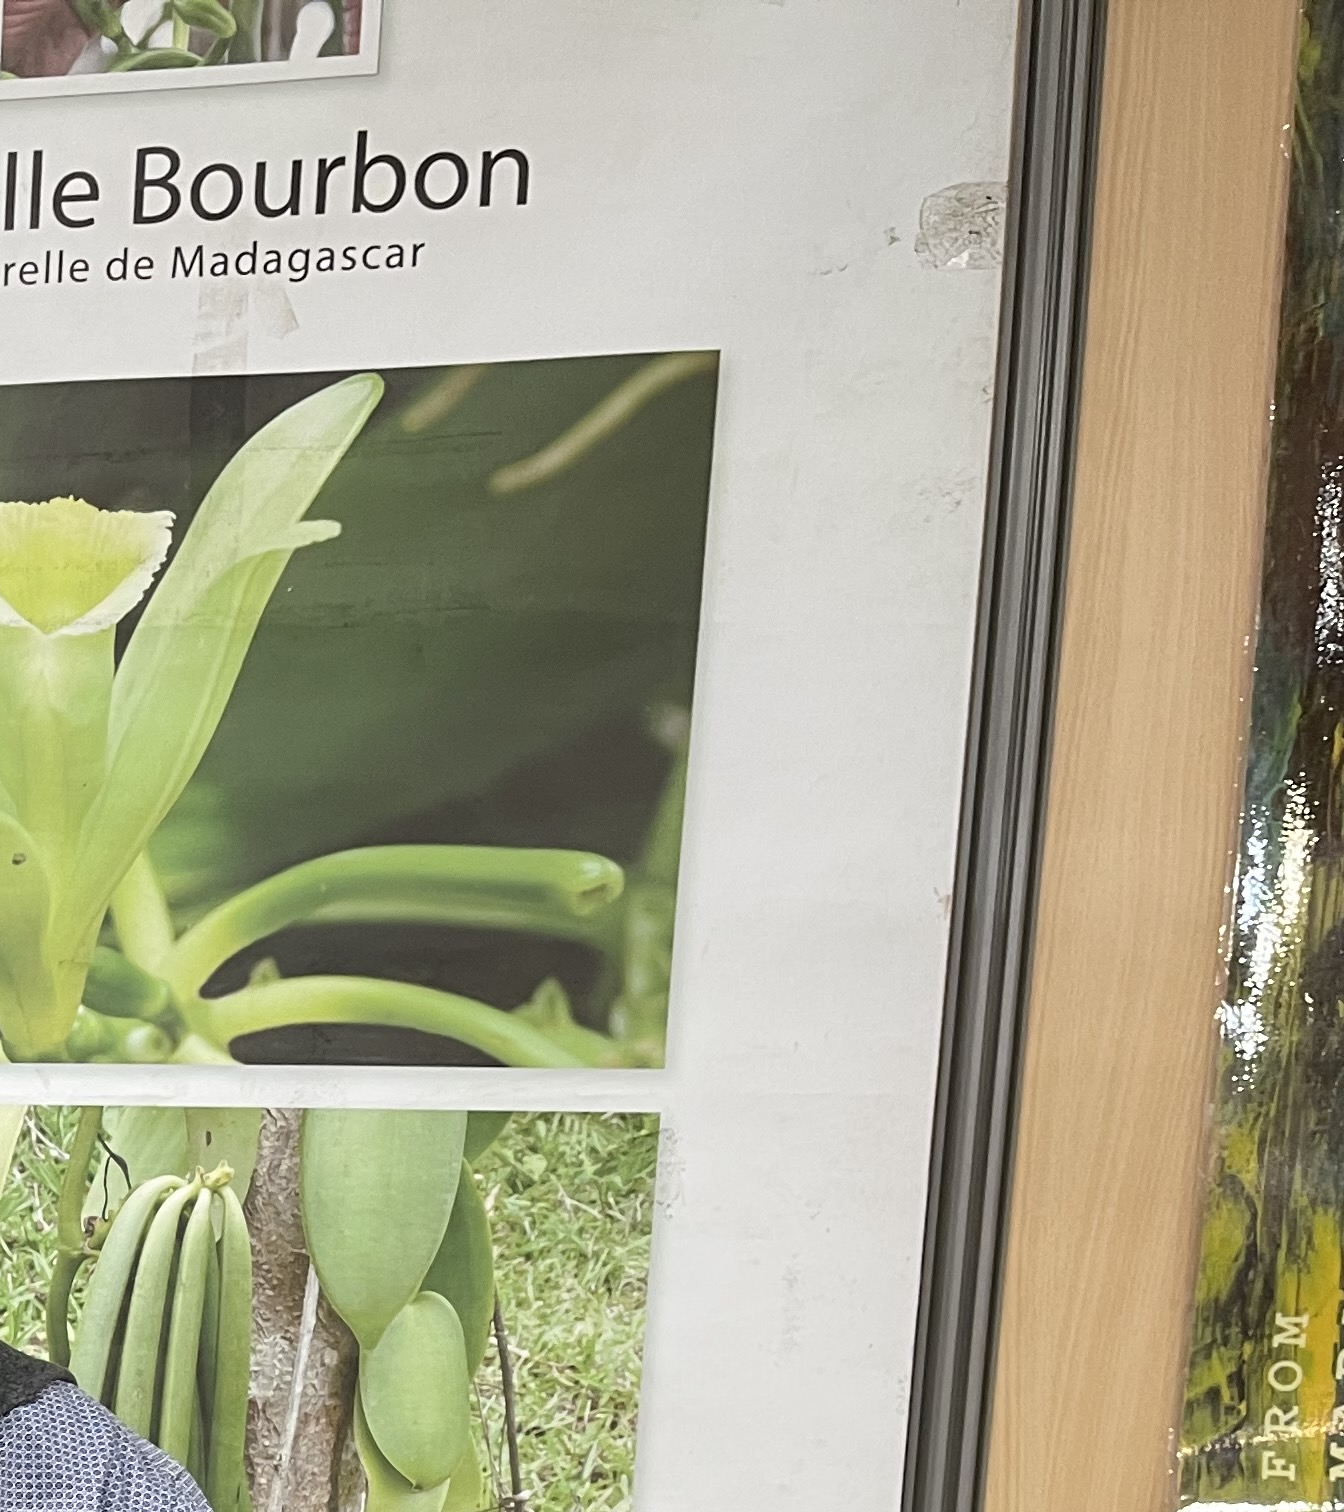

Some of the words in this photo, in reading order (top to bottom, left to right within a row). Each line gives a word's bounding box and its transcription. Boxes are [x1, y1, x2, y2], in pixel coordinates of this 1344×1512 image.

[131, 129, 532, 226] Bourbon
[105, 245, 155, 282] de
[170, 236, 427, 283] Madagascar
[1262, 1312, 1311, 1482] FROM
